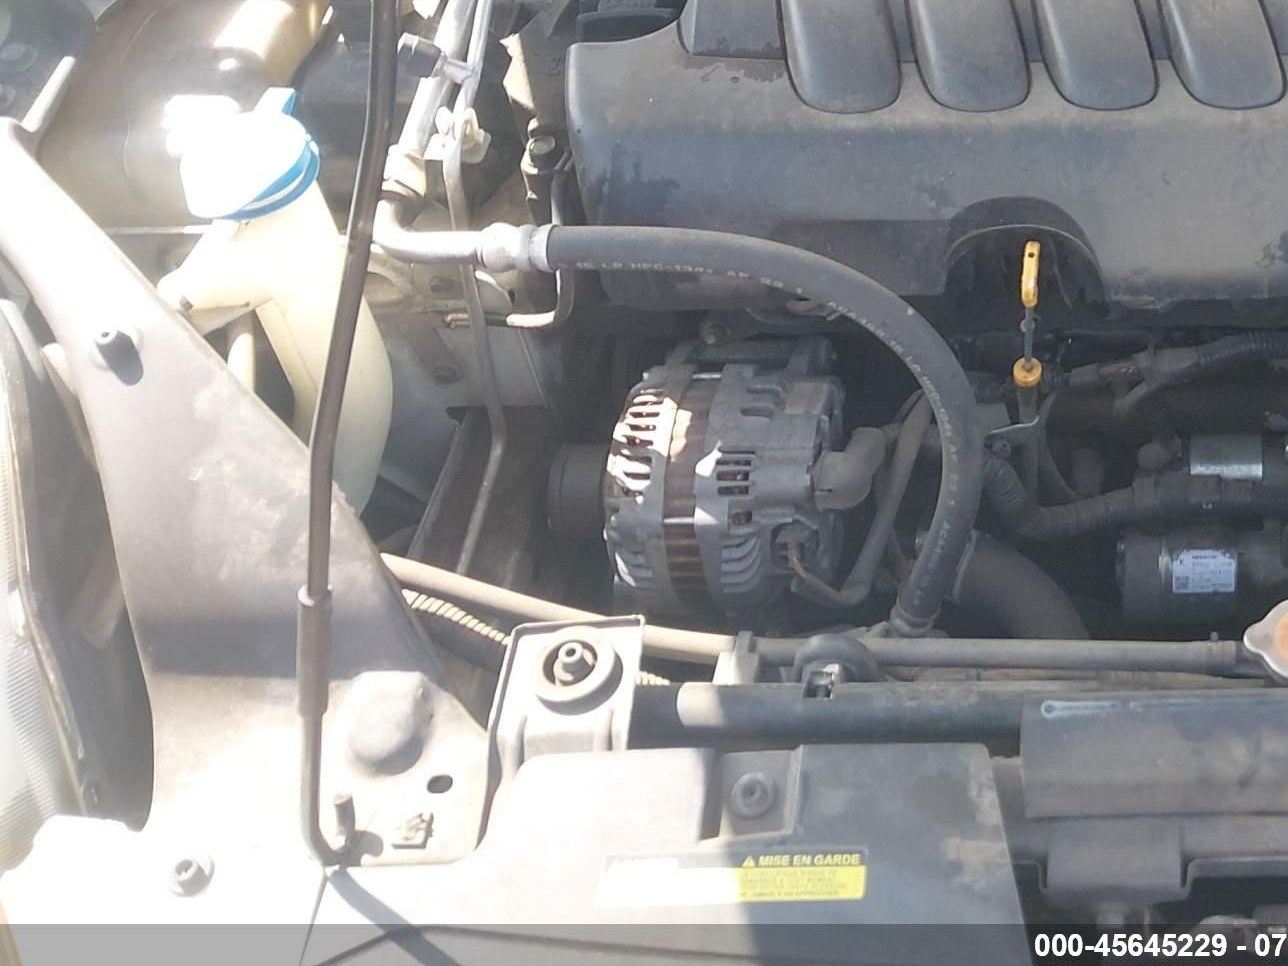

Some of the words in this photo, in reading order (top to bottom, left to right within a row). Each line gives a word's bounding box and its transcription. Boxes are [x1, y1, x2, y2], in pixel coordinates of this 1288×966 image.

[758, 854, 790, 867] MISE
[793, 854, 811, 866] EN
[813, 853, 861, 866] GARDE
